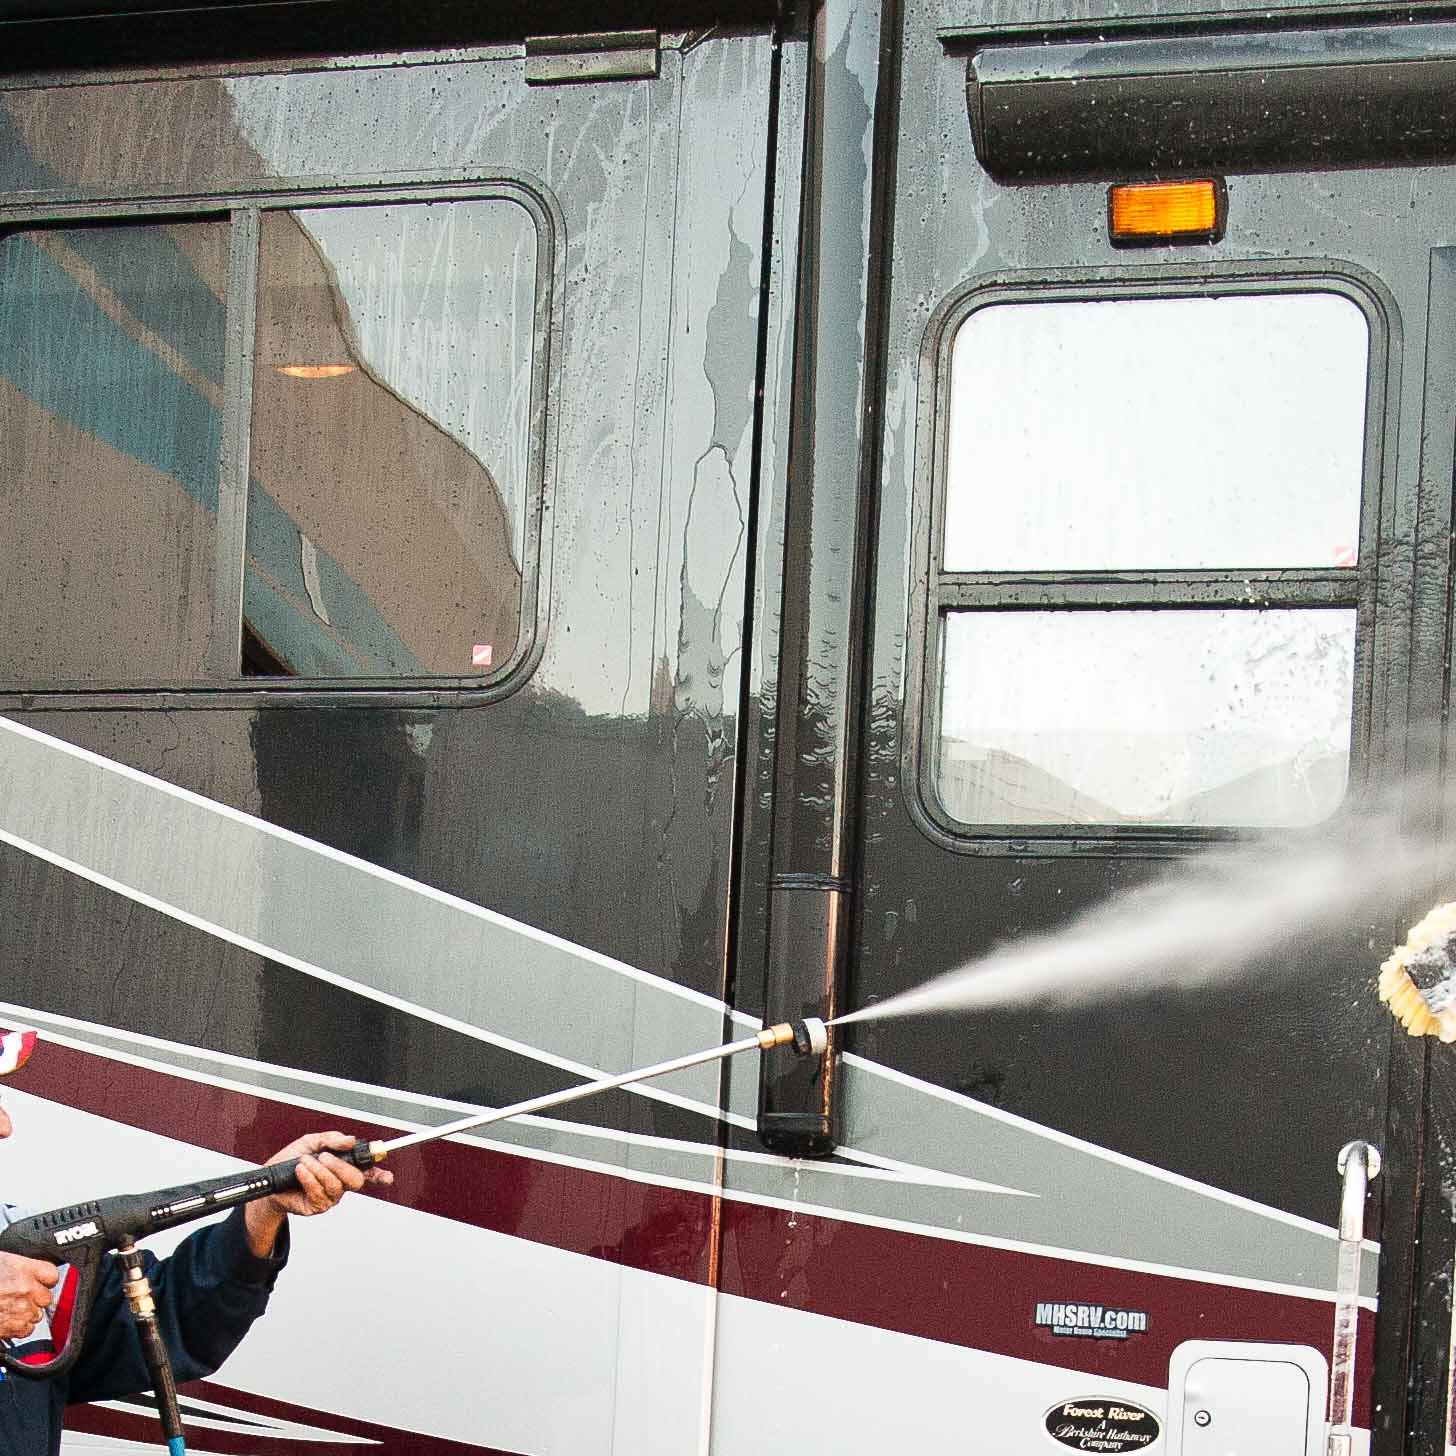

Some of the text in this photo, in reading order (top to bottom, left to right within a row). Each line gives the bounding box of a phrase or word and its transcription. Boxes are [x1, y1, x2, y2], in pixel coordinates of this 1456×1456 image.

[54, 1222, 99, 1245] RYOBI
[1036, 1303, 1146, 1330] MHSRV.com
[1063, 1404, 1144, 1420] Forest River
[1054, 1423, 1152, 1444] Berkshire Hathaway
[1097, 1419, 1106, 1430] A
[1079, 1438, 1123, 1452] Company
